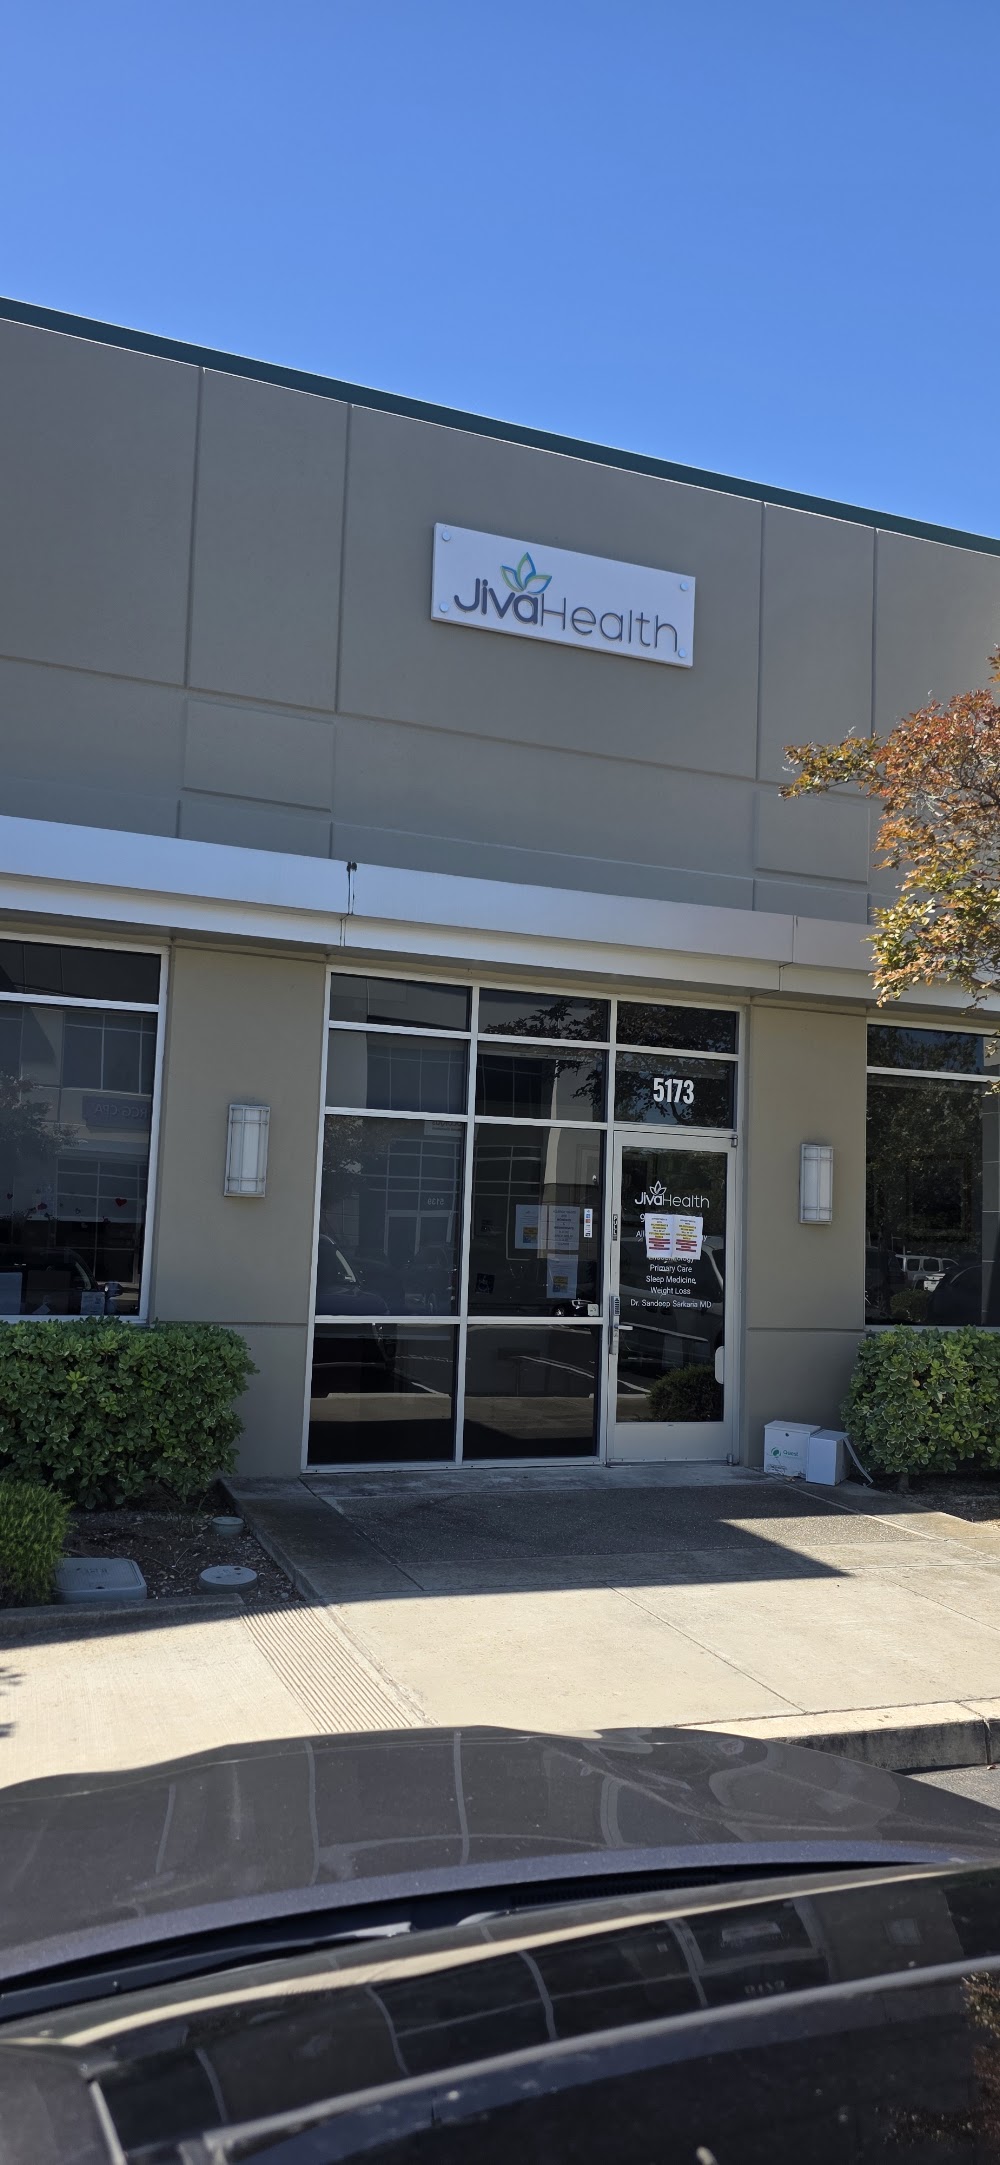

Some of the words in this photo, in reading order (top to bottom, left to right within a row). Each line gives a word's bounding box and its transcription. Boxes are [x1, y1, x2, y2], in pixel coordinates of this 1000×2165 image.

[454, 577, 678, 653] JivaHealth
[653, 1078, 694, 1104] 5173
[635, 1191, 709, 1208] JivaHealth
[649, 1263, 676, 1273] Primary
[676, 1264, 693, 1273] Care
[645, 1275, 665, 1284] Sleep
[650, 1286, 674, 1295] Weight
[674, 1287, 691, 1295] Loss
[630, 1298, 640, 1307] Dr.
[641, 1299, 671, 1308] Sandeep
[699, 1300, 712, 1308] MD
